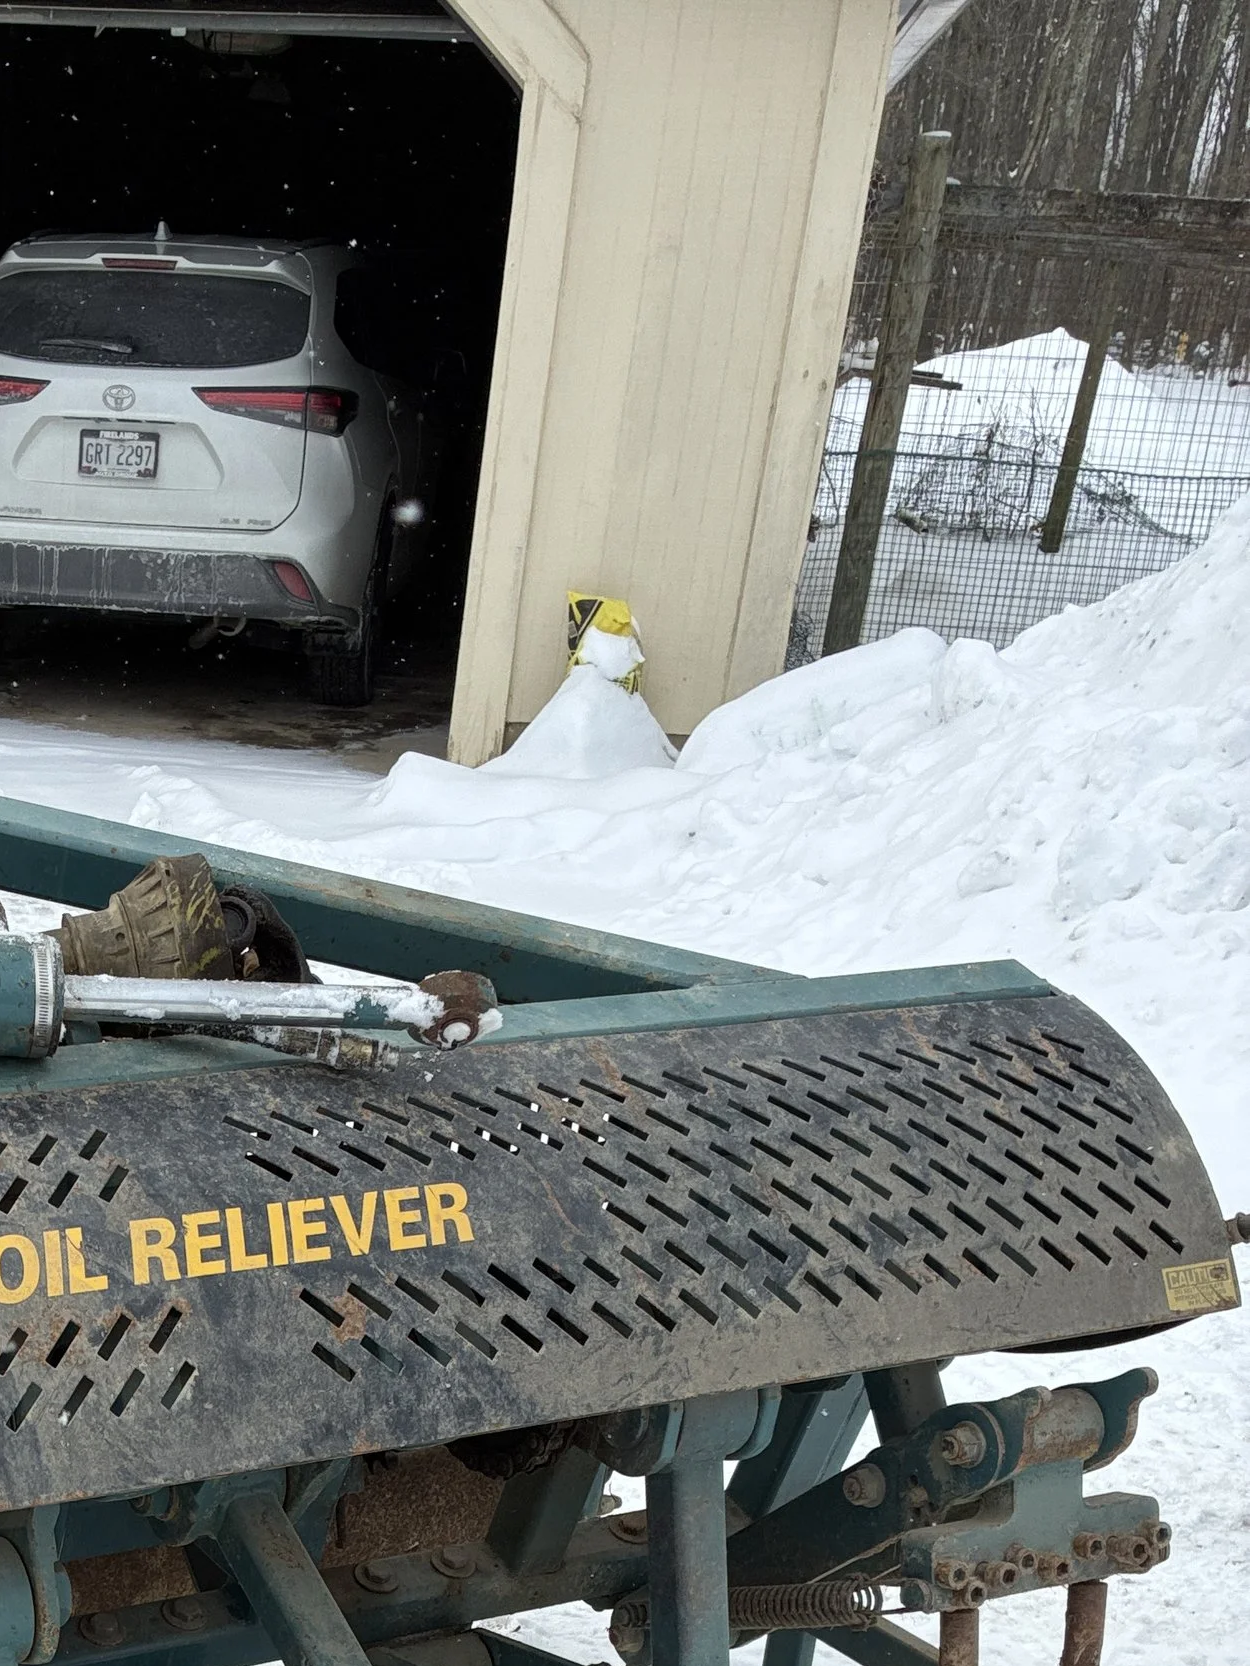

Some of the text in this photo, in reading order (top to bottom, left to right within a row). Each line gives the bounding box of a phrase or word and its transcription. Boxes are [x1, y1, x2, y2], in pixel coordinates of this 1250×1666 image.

[86, 443, 152, 466] GRT 2297
[128, 1181, 476, 1286] RELIEVER
